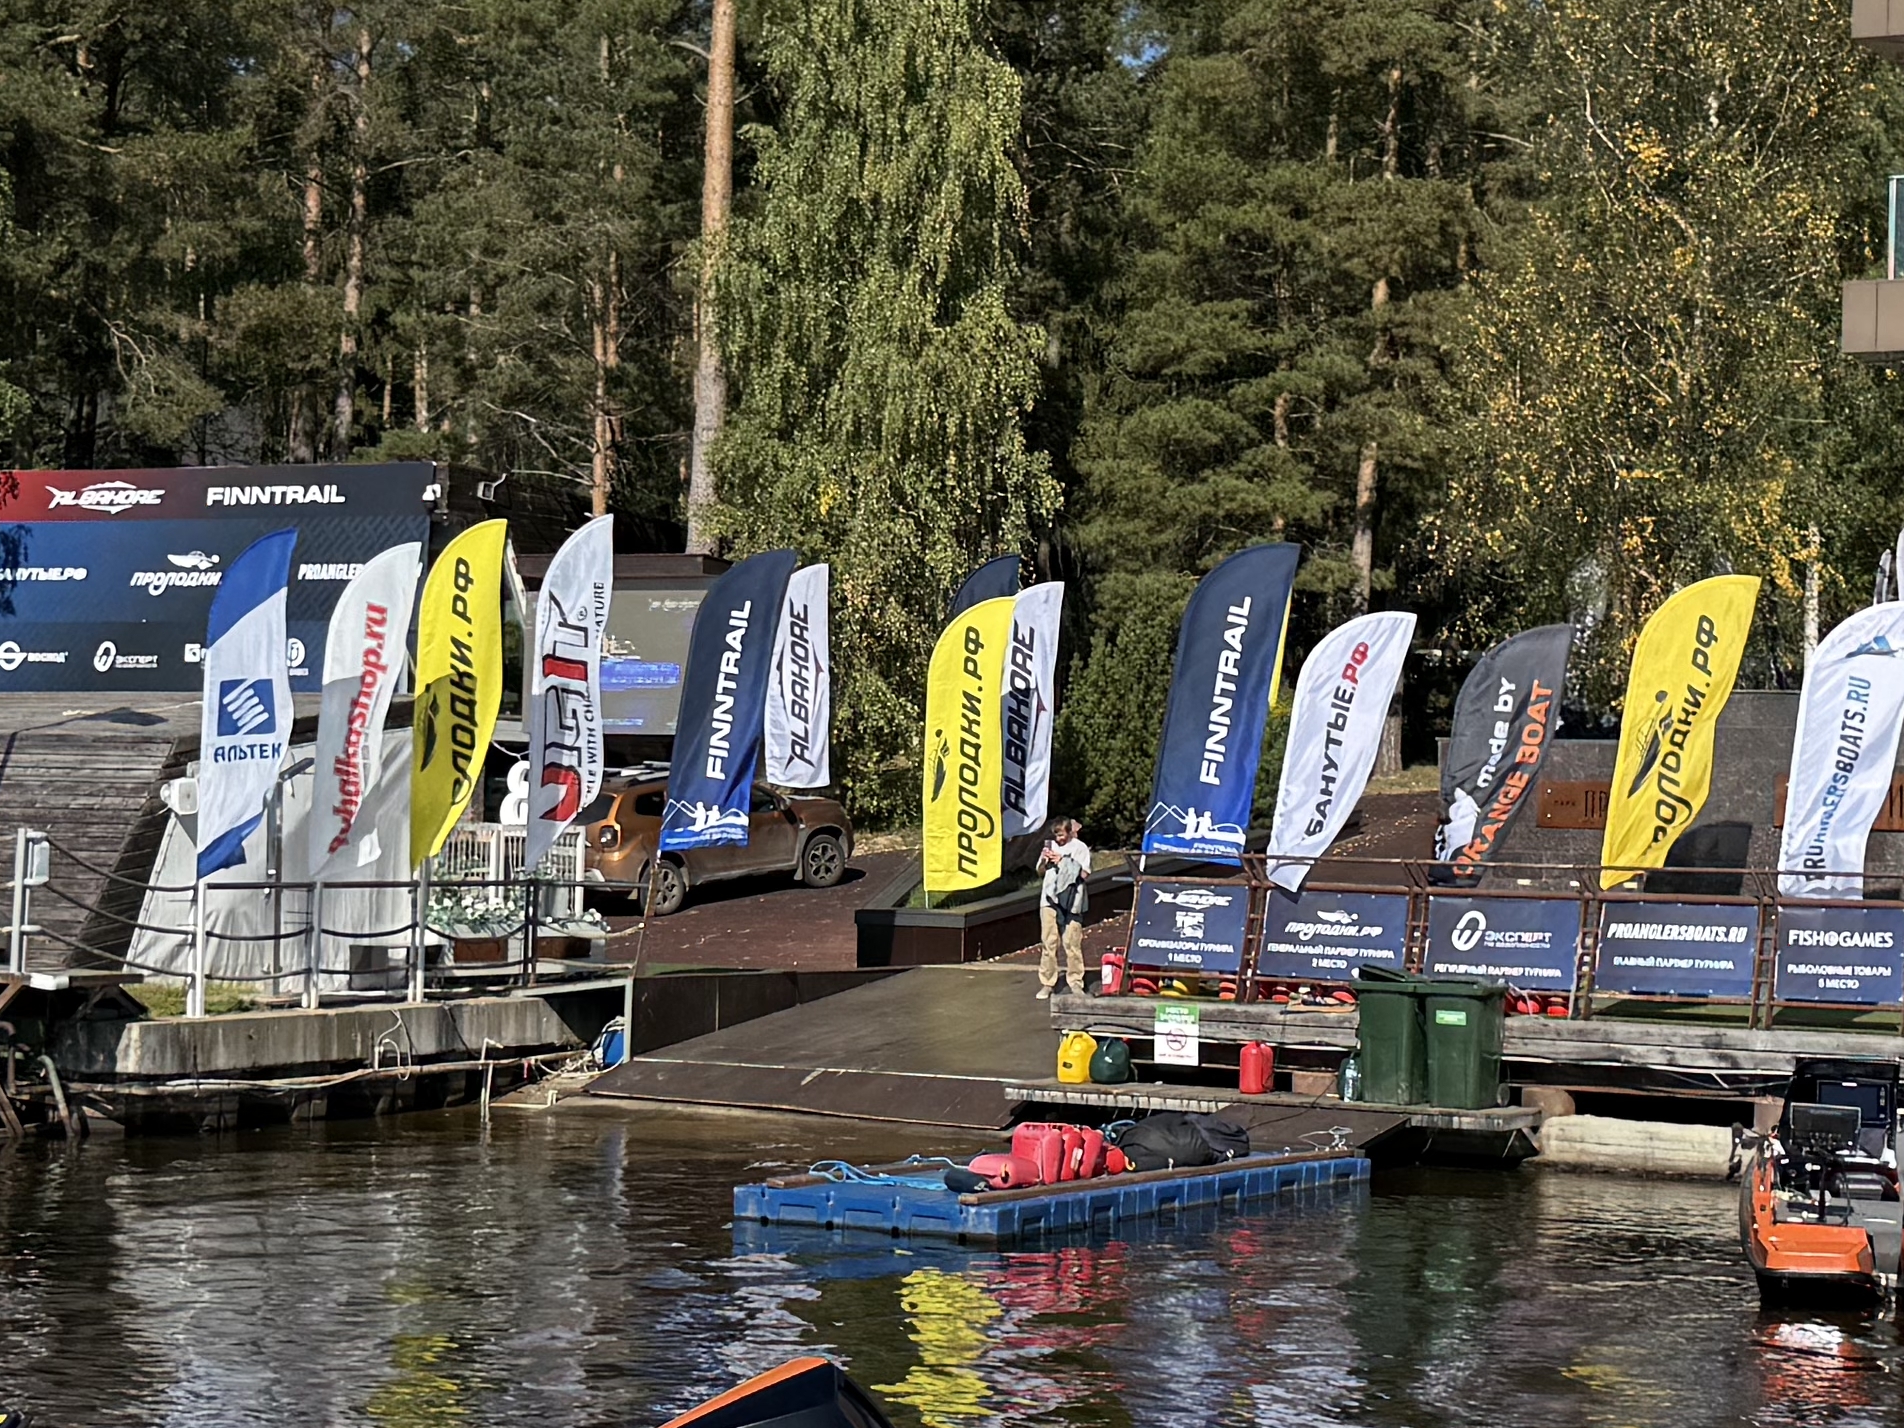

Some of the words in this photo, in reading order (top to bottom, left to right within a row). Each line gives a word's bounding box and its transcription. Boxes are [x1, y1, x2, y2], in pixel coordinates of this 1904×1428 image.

[206, 484, 346, 507] FINNTRAIL
[213, 742, 282, 764] АЛЬТЕК
[706, 599, 752, 781] FINNTRAIL
[786, 598, 817, 771] ALBAKORE
[957, 625, 995, 878] ПРОЛОДКИ.РФ
[1003, 618, 1036, 818] ALBAKORE
[1199, 595, 1253, 786] FINNTRAIL
[1452, 769, 1531, 876] ORANGE
[1515, 679, 1553, 765] BOAT
